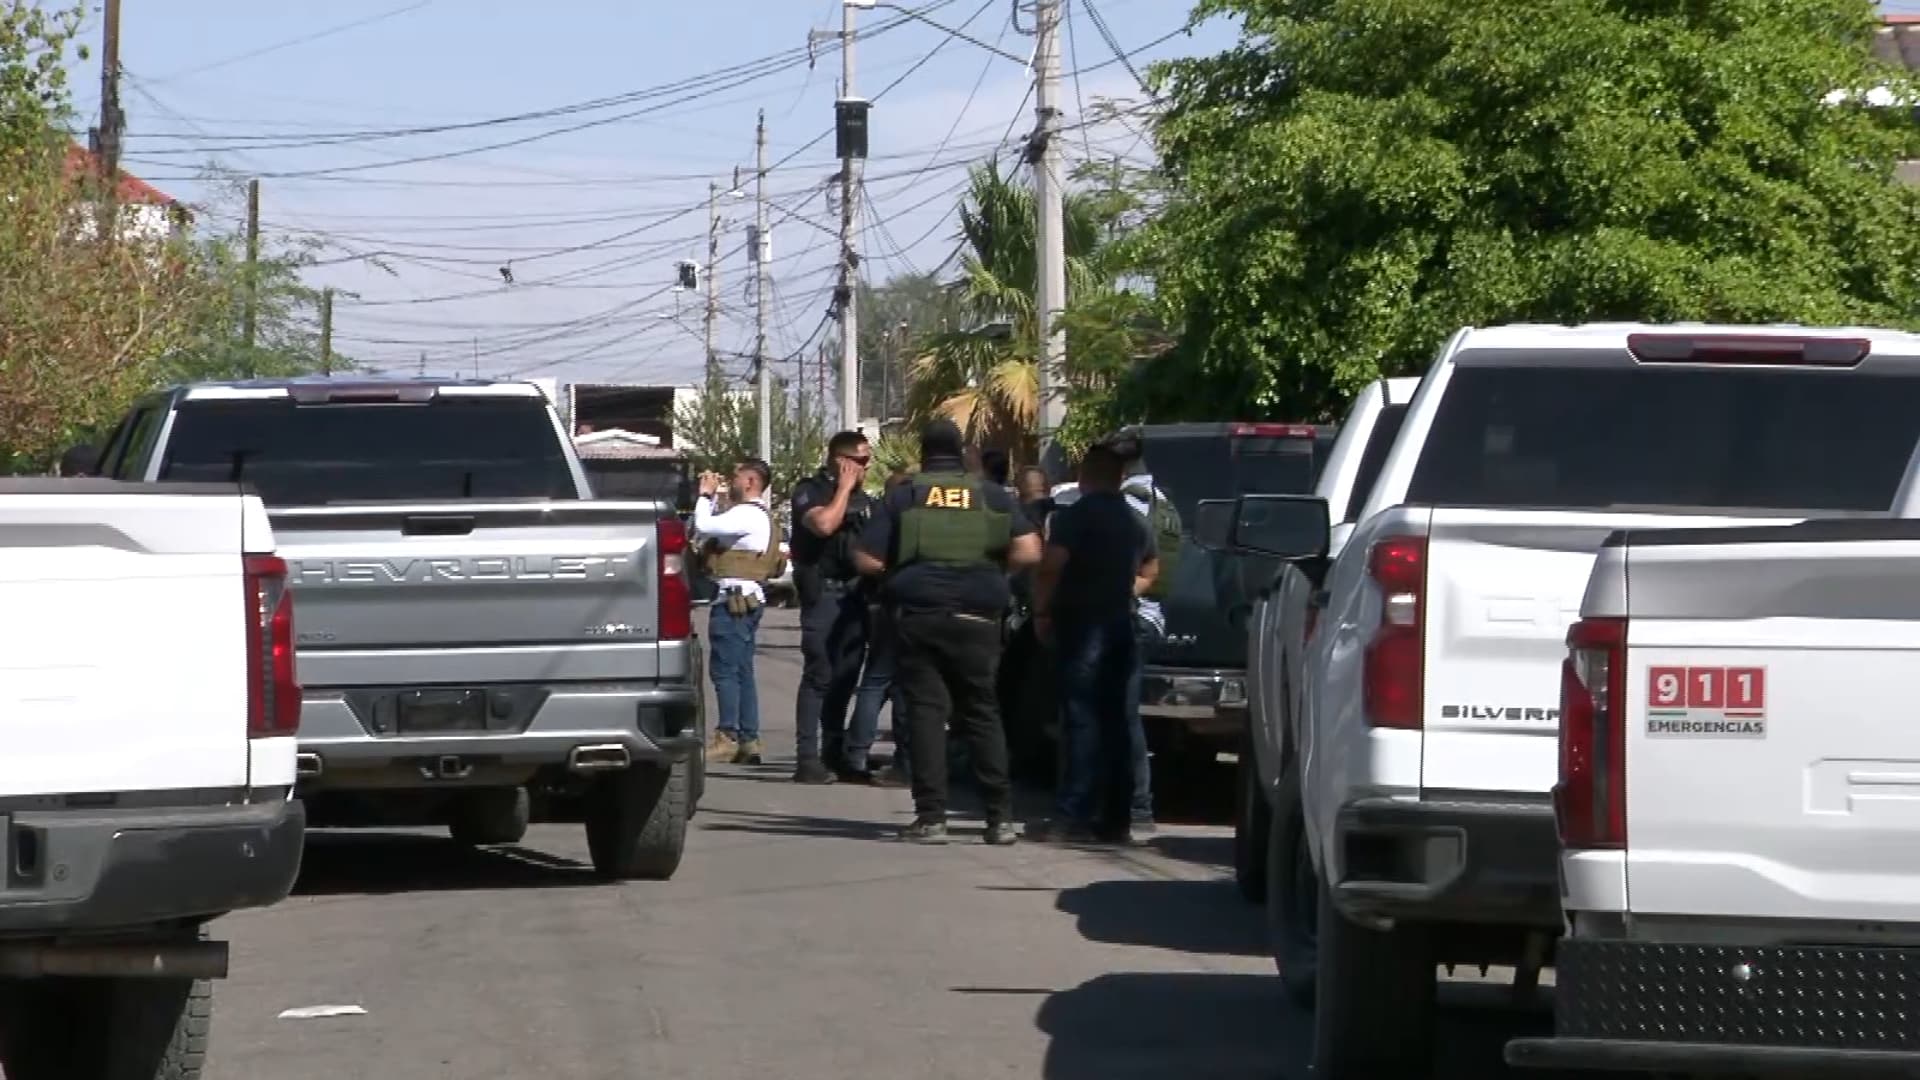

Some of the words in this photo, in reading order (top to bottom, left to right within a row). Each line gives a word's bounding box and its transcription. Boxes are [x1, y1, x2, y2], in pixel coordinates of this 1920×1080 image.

[925, 485, 970, 509] AEI
[1656, 673, 1752, 703] 911
[1647, 721, 1764, 734] EMERGENCIAS
